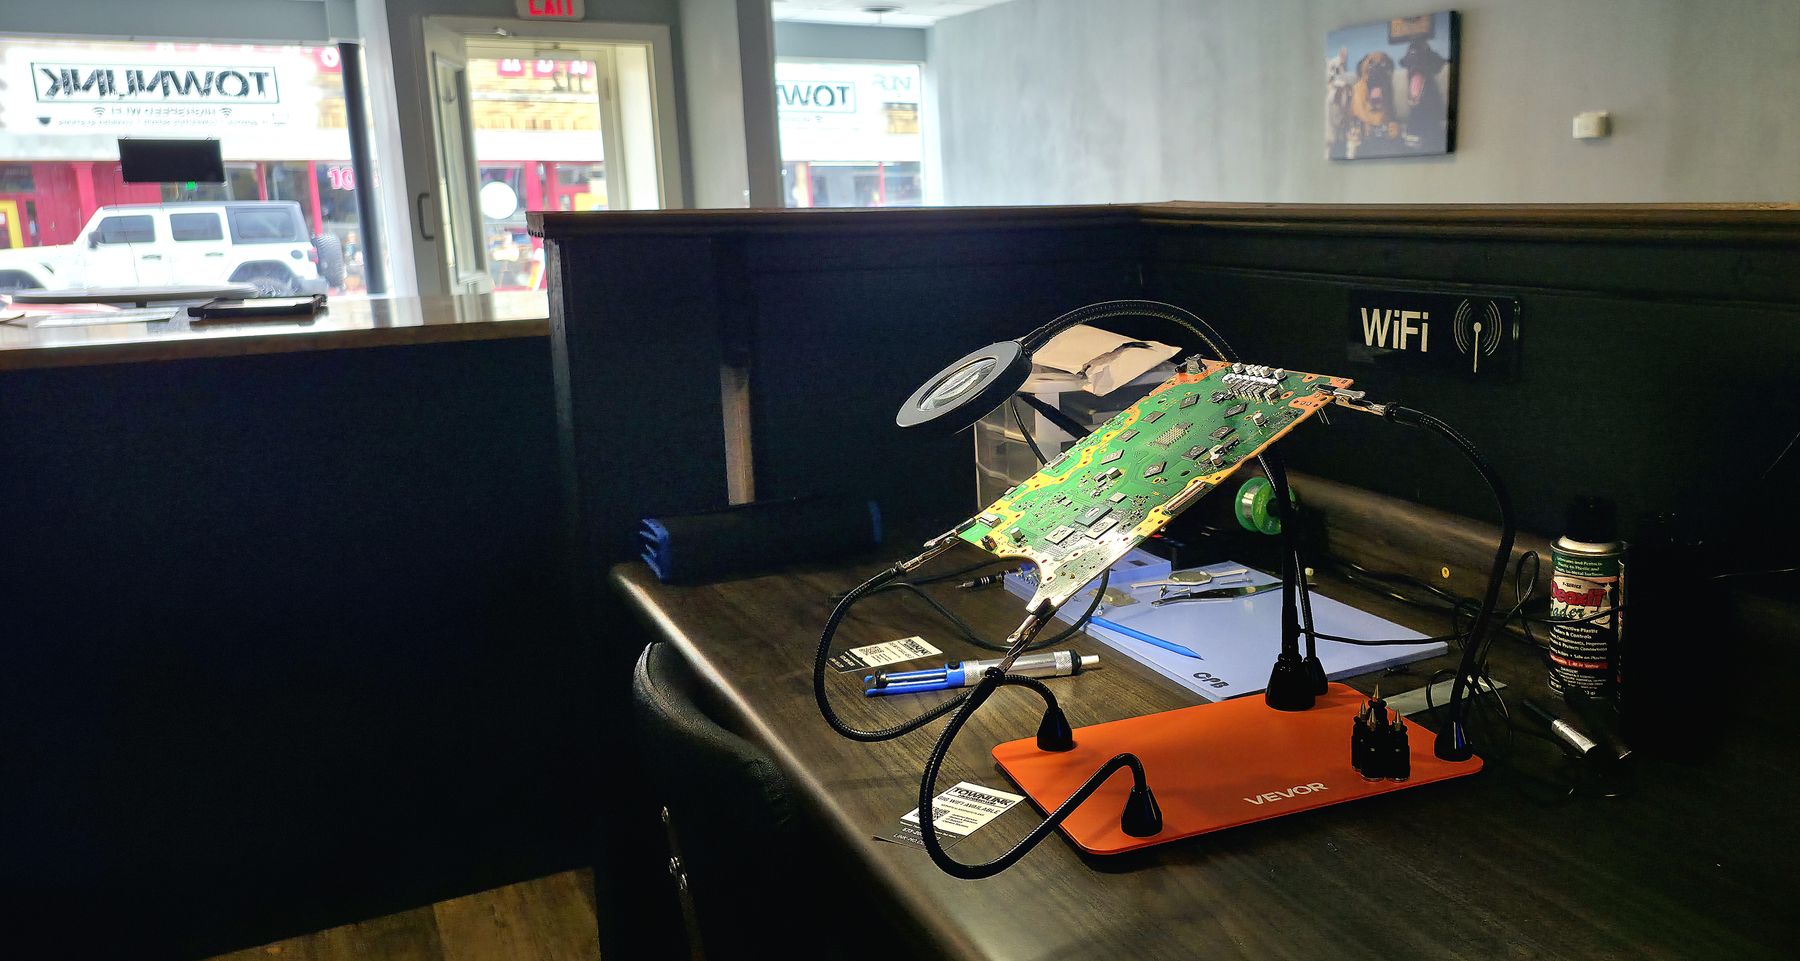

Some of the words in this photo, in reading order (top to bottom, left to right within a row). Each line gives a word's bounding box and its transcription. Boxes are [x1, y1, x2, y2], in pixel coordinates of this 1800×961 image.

[1361, 307, 1429, 353] WiFi
[1243, 782, 1328, 805] VEVOR
[963, 802, 1001, 814] AVAILABLE
